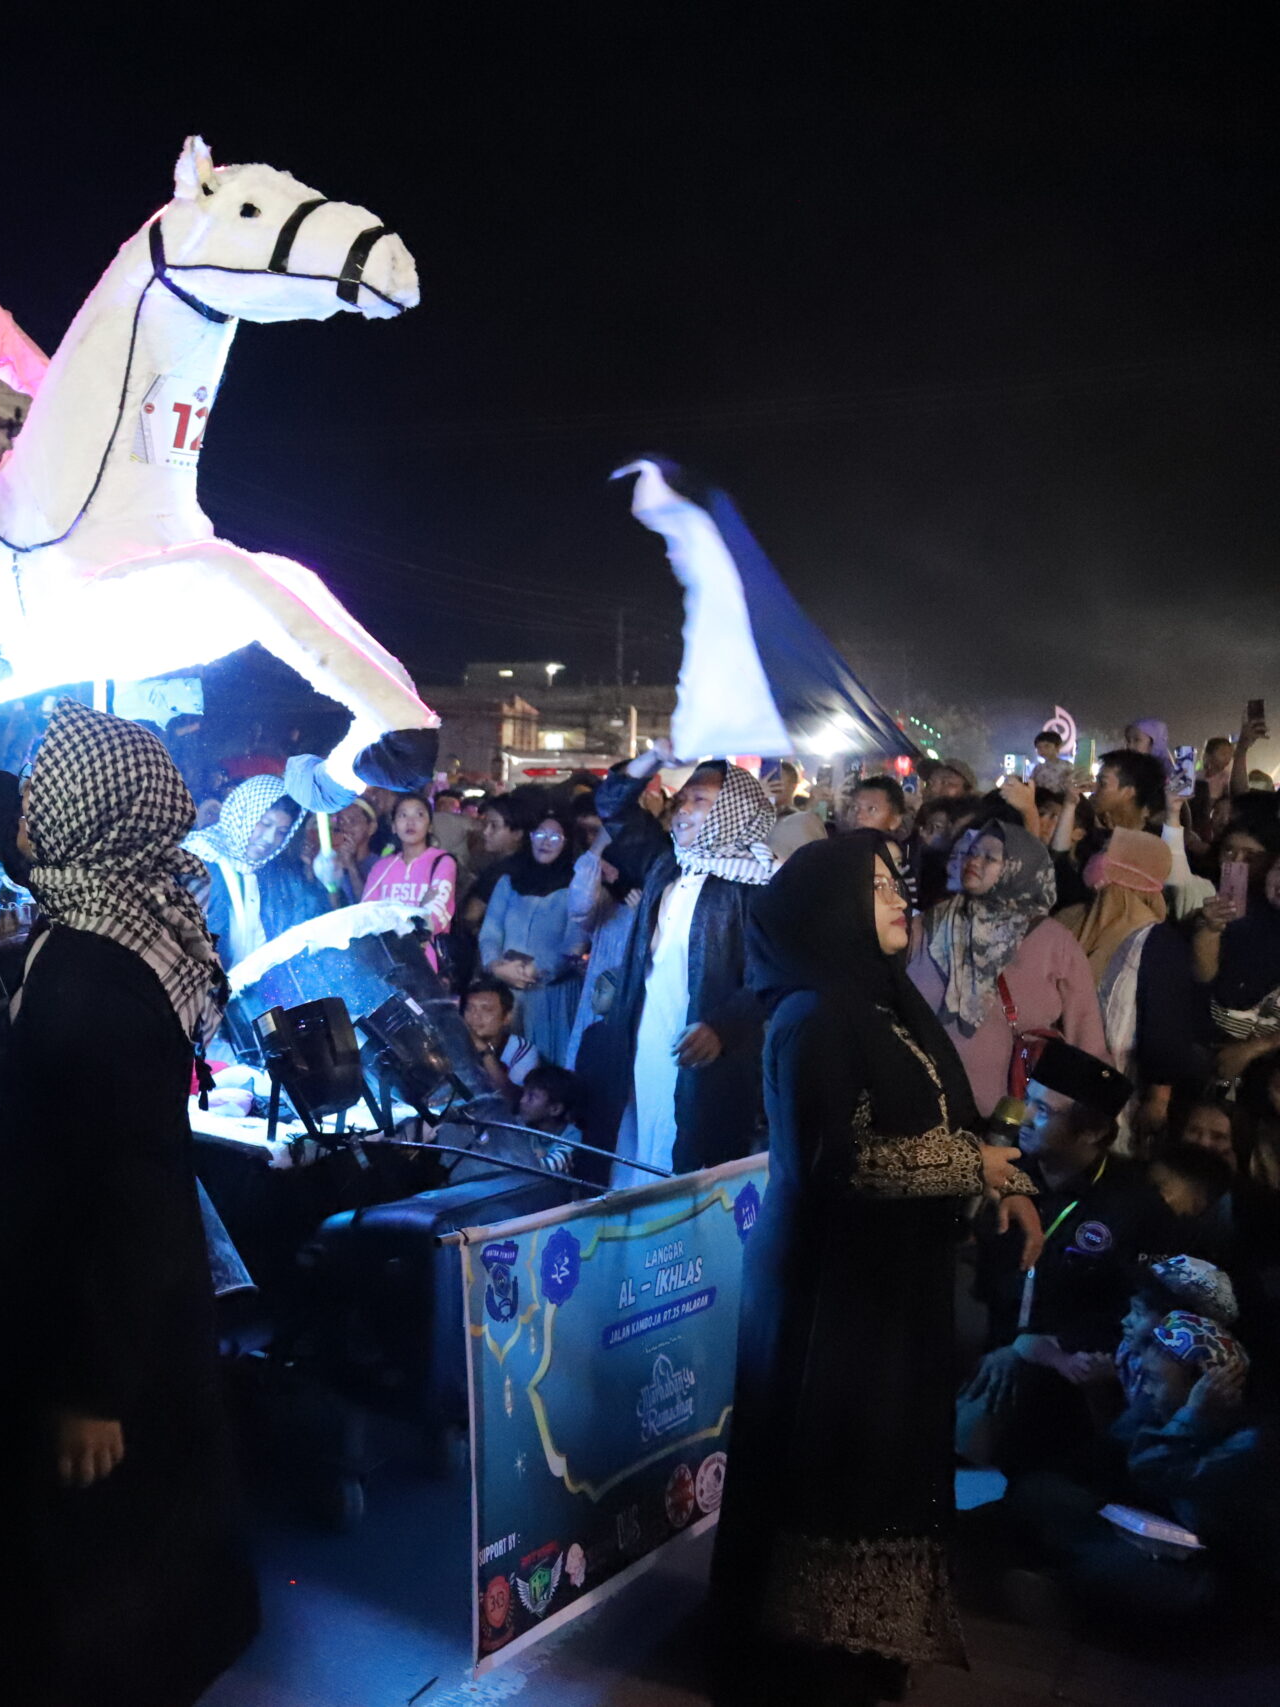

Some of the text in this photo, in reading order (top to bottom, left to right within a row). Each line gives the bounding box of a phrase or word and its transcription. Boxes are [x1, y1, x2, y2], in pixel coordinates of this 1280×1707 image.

[645, 1240, 684, 1268] LANGGAR
[619, 1279, 636, 1309] AL
[655, 1256, 703, 1297] IKHLAS
[609, 1325, 631, 1345] JALAN
[631, 1313, 662, 1336] KAMBOJA
[681, 1294, 710, 1315] PALARAN
[479, 1538, 507, 1567] SUPPORT
[508, 1532, 516, 1551] BY
